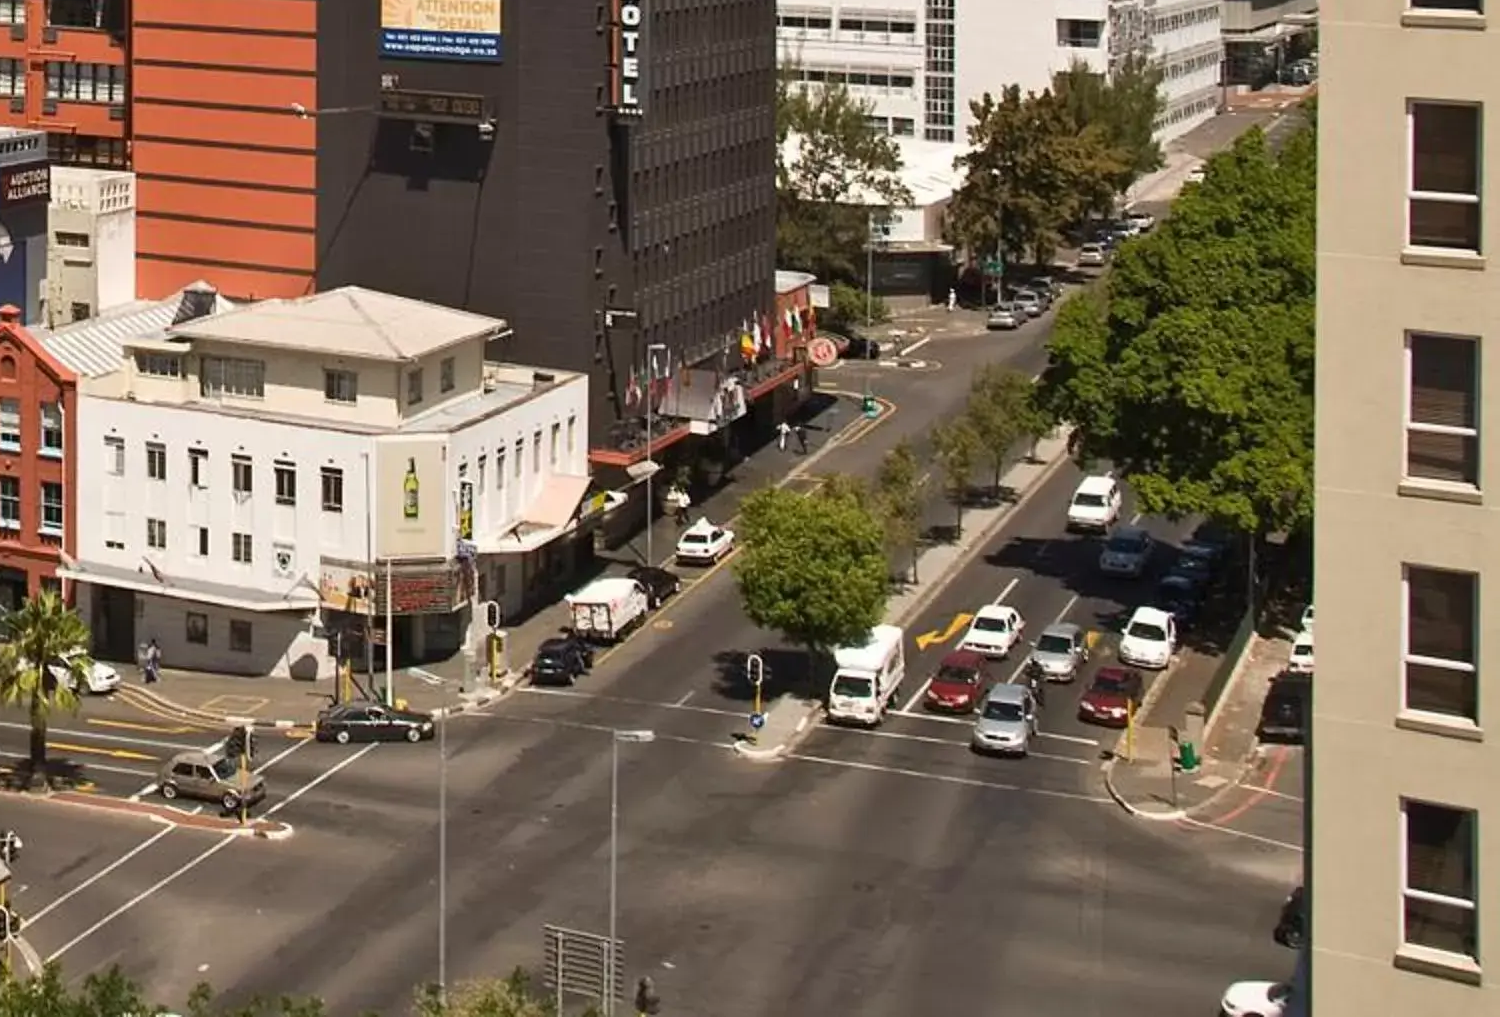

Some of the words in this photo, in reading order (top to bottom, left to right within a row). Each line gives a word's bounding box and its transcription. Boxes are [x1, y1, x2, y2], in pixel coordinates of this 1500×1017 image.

[437, 17, 488, 30] DETAIL
[10, 168, 48, 186] AUCTION
[7, 182, 49, 200] ALLIANCE
